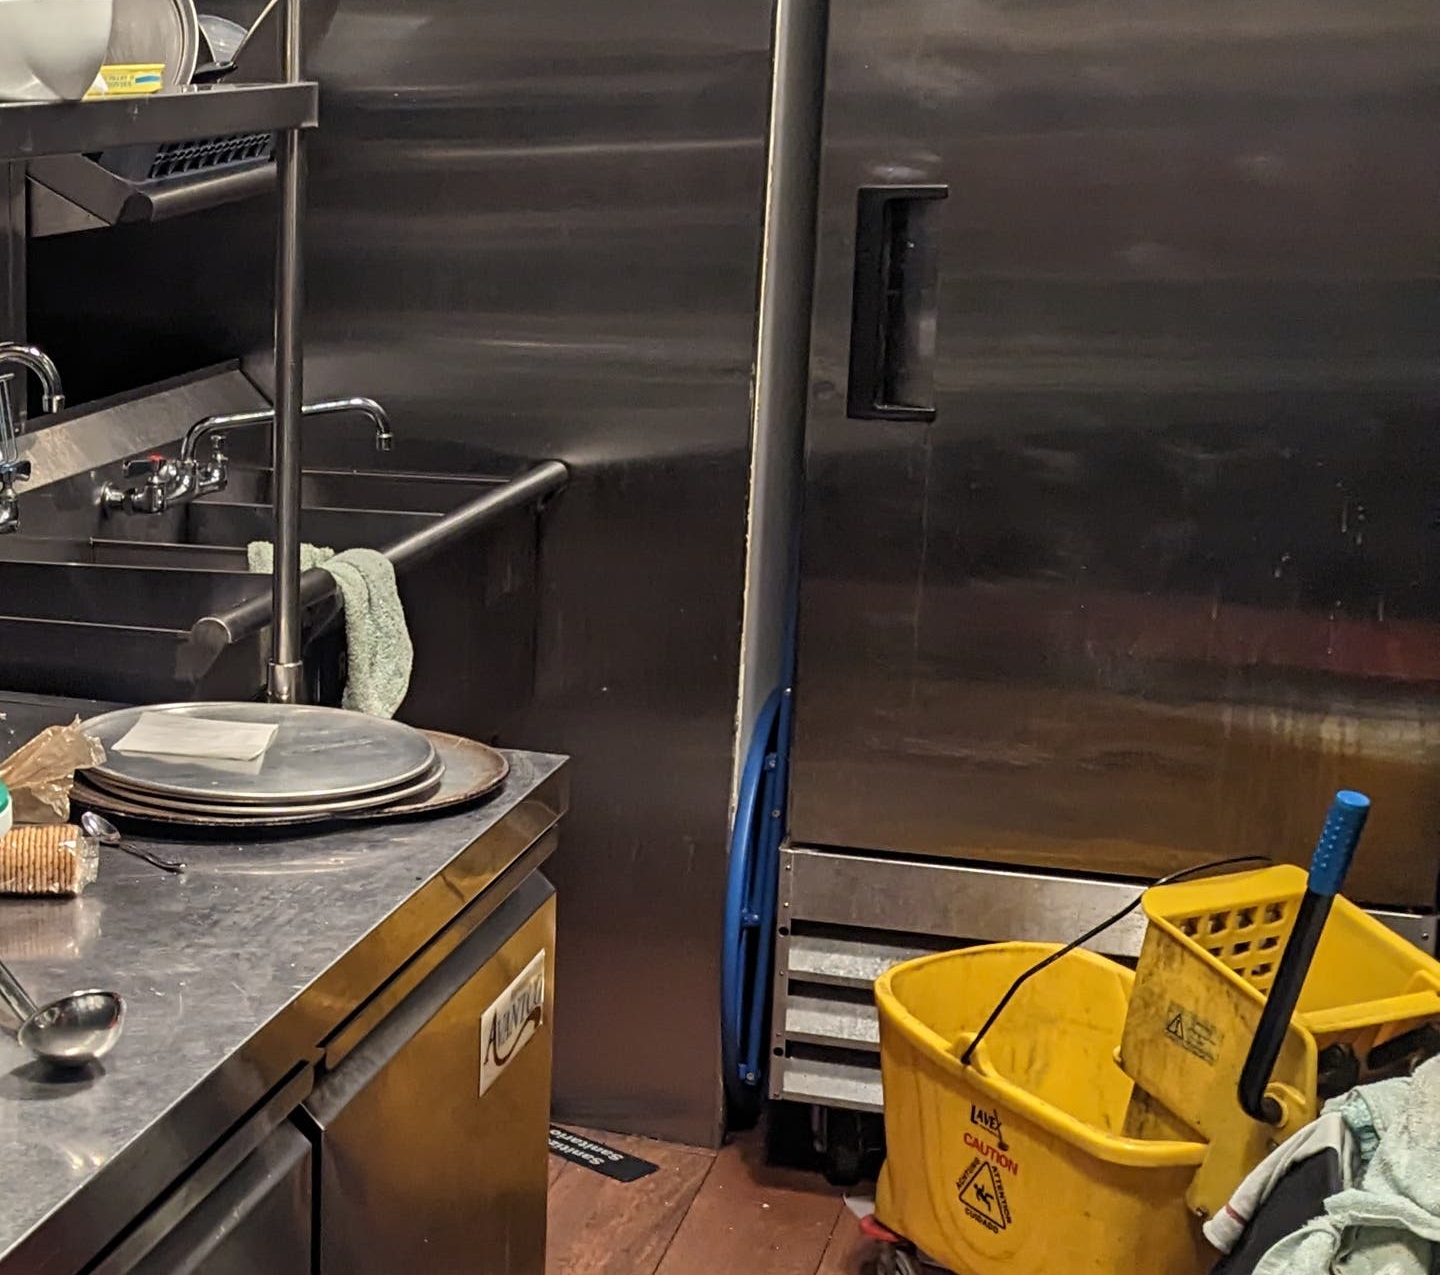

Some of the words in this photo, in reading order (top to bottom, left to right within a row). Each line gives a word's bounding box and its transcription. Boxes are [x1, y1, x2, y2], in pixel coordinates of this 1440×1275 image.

[970, 1105, 1003, 1131] LAVEX
[549, 1129, 625, 1162] Sanitario
[964, 1132, 1018, 1176] CAUTION
[992, 1165, 1012, 1224] ATTENTION
[965, 1207, 999, 1235] CUIDADO
